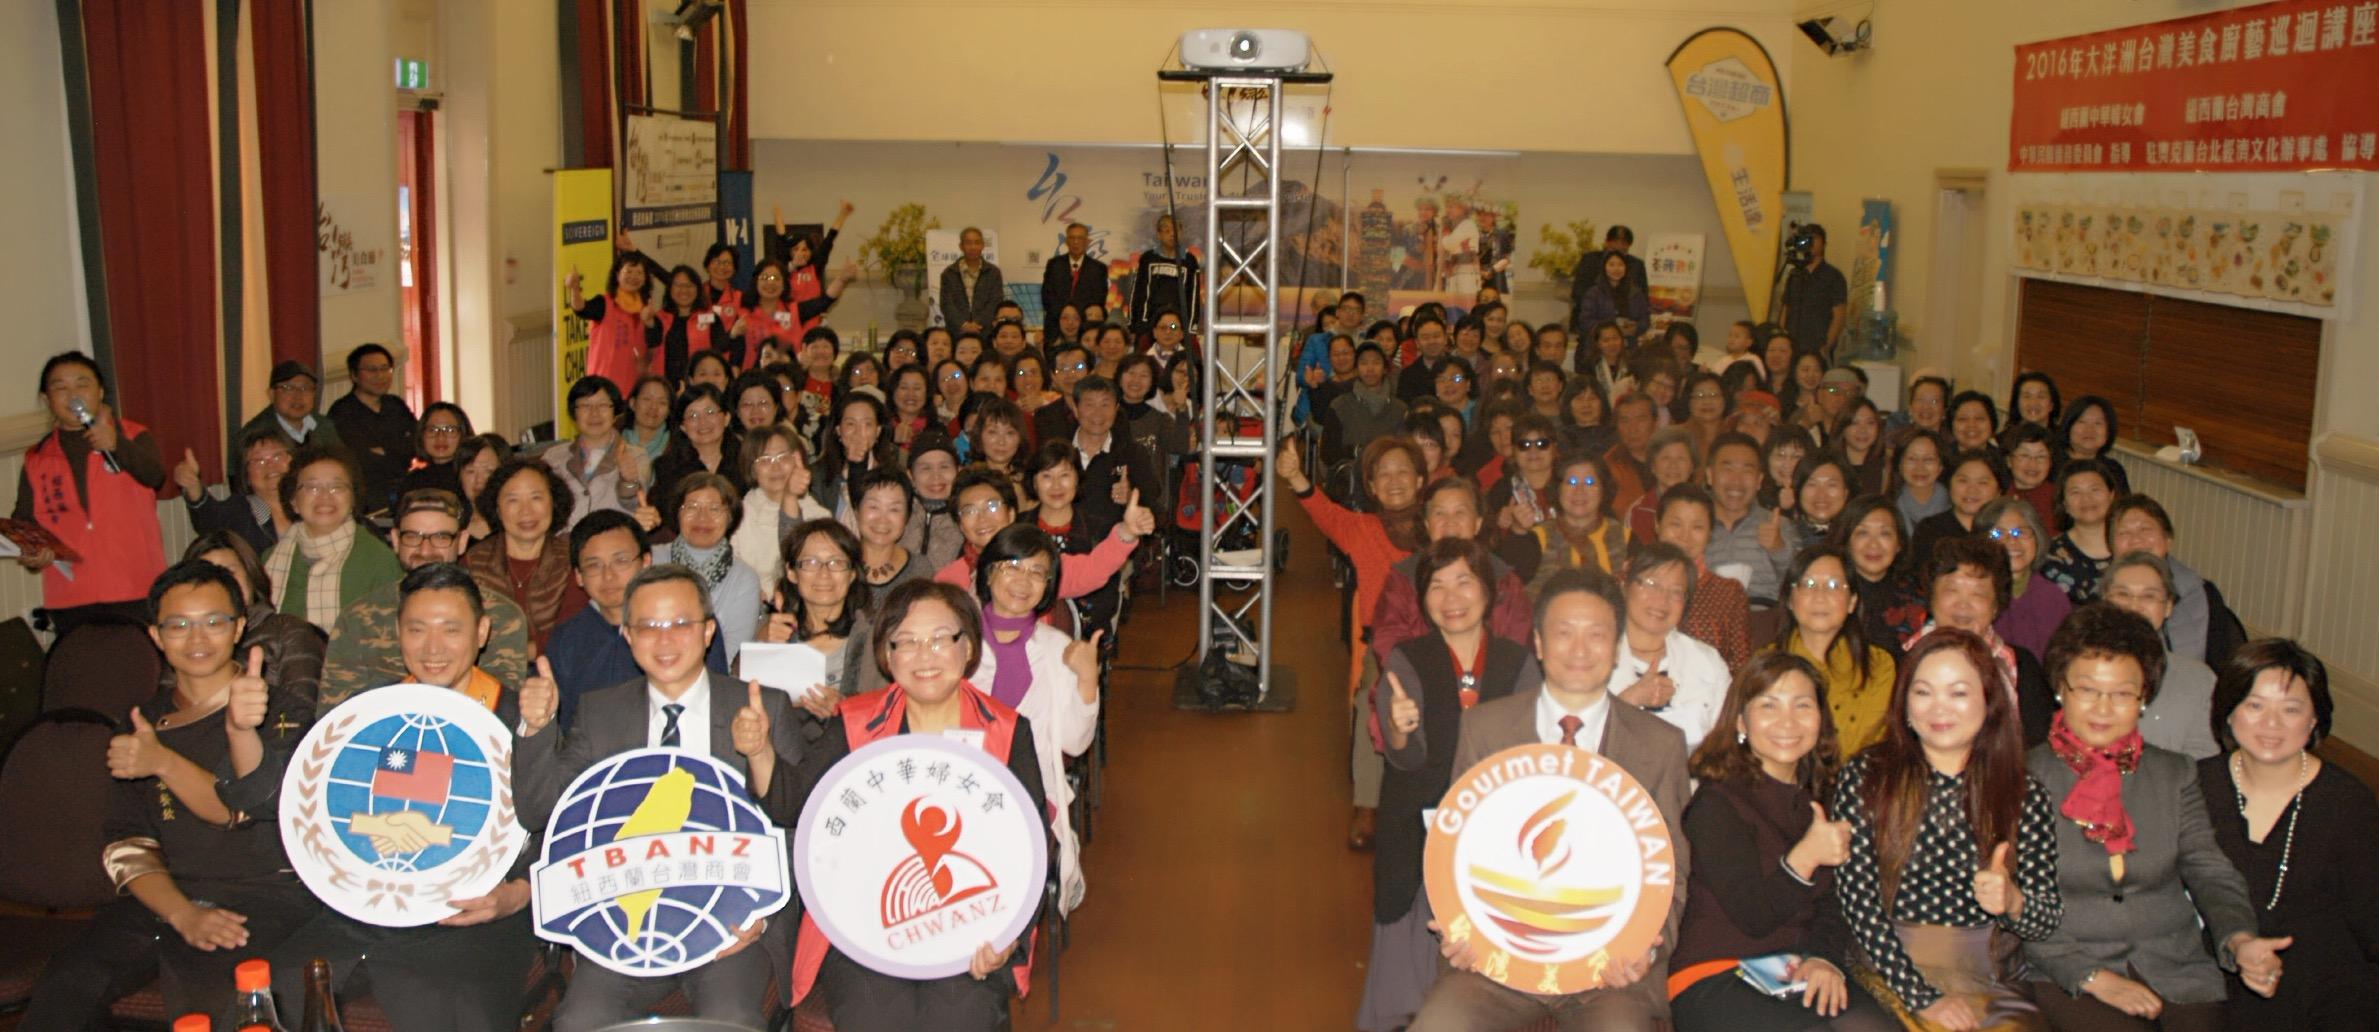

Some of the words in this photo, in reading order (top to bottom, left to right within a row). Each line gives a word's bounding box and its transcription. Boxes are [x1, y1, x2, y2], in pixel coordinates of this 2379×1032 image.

[1176, 191, 1209, 201] Truste
[565, 223, 605, 241] SOVEREIGN
[563, 315, 589, 347] TAKE
[564, 350, 588, 384] CHA
[1436, 750, 1575, 836] Gourmet
[1585, 758, 1672, 887] TAIWAN
[567, 835, 752, 879] TBANZ
[570, 859, 752, 905] 紐西蘭台灣商會
[887, 893, 1007, 951] CHWANZ
